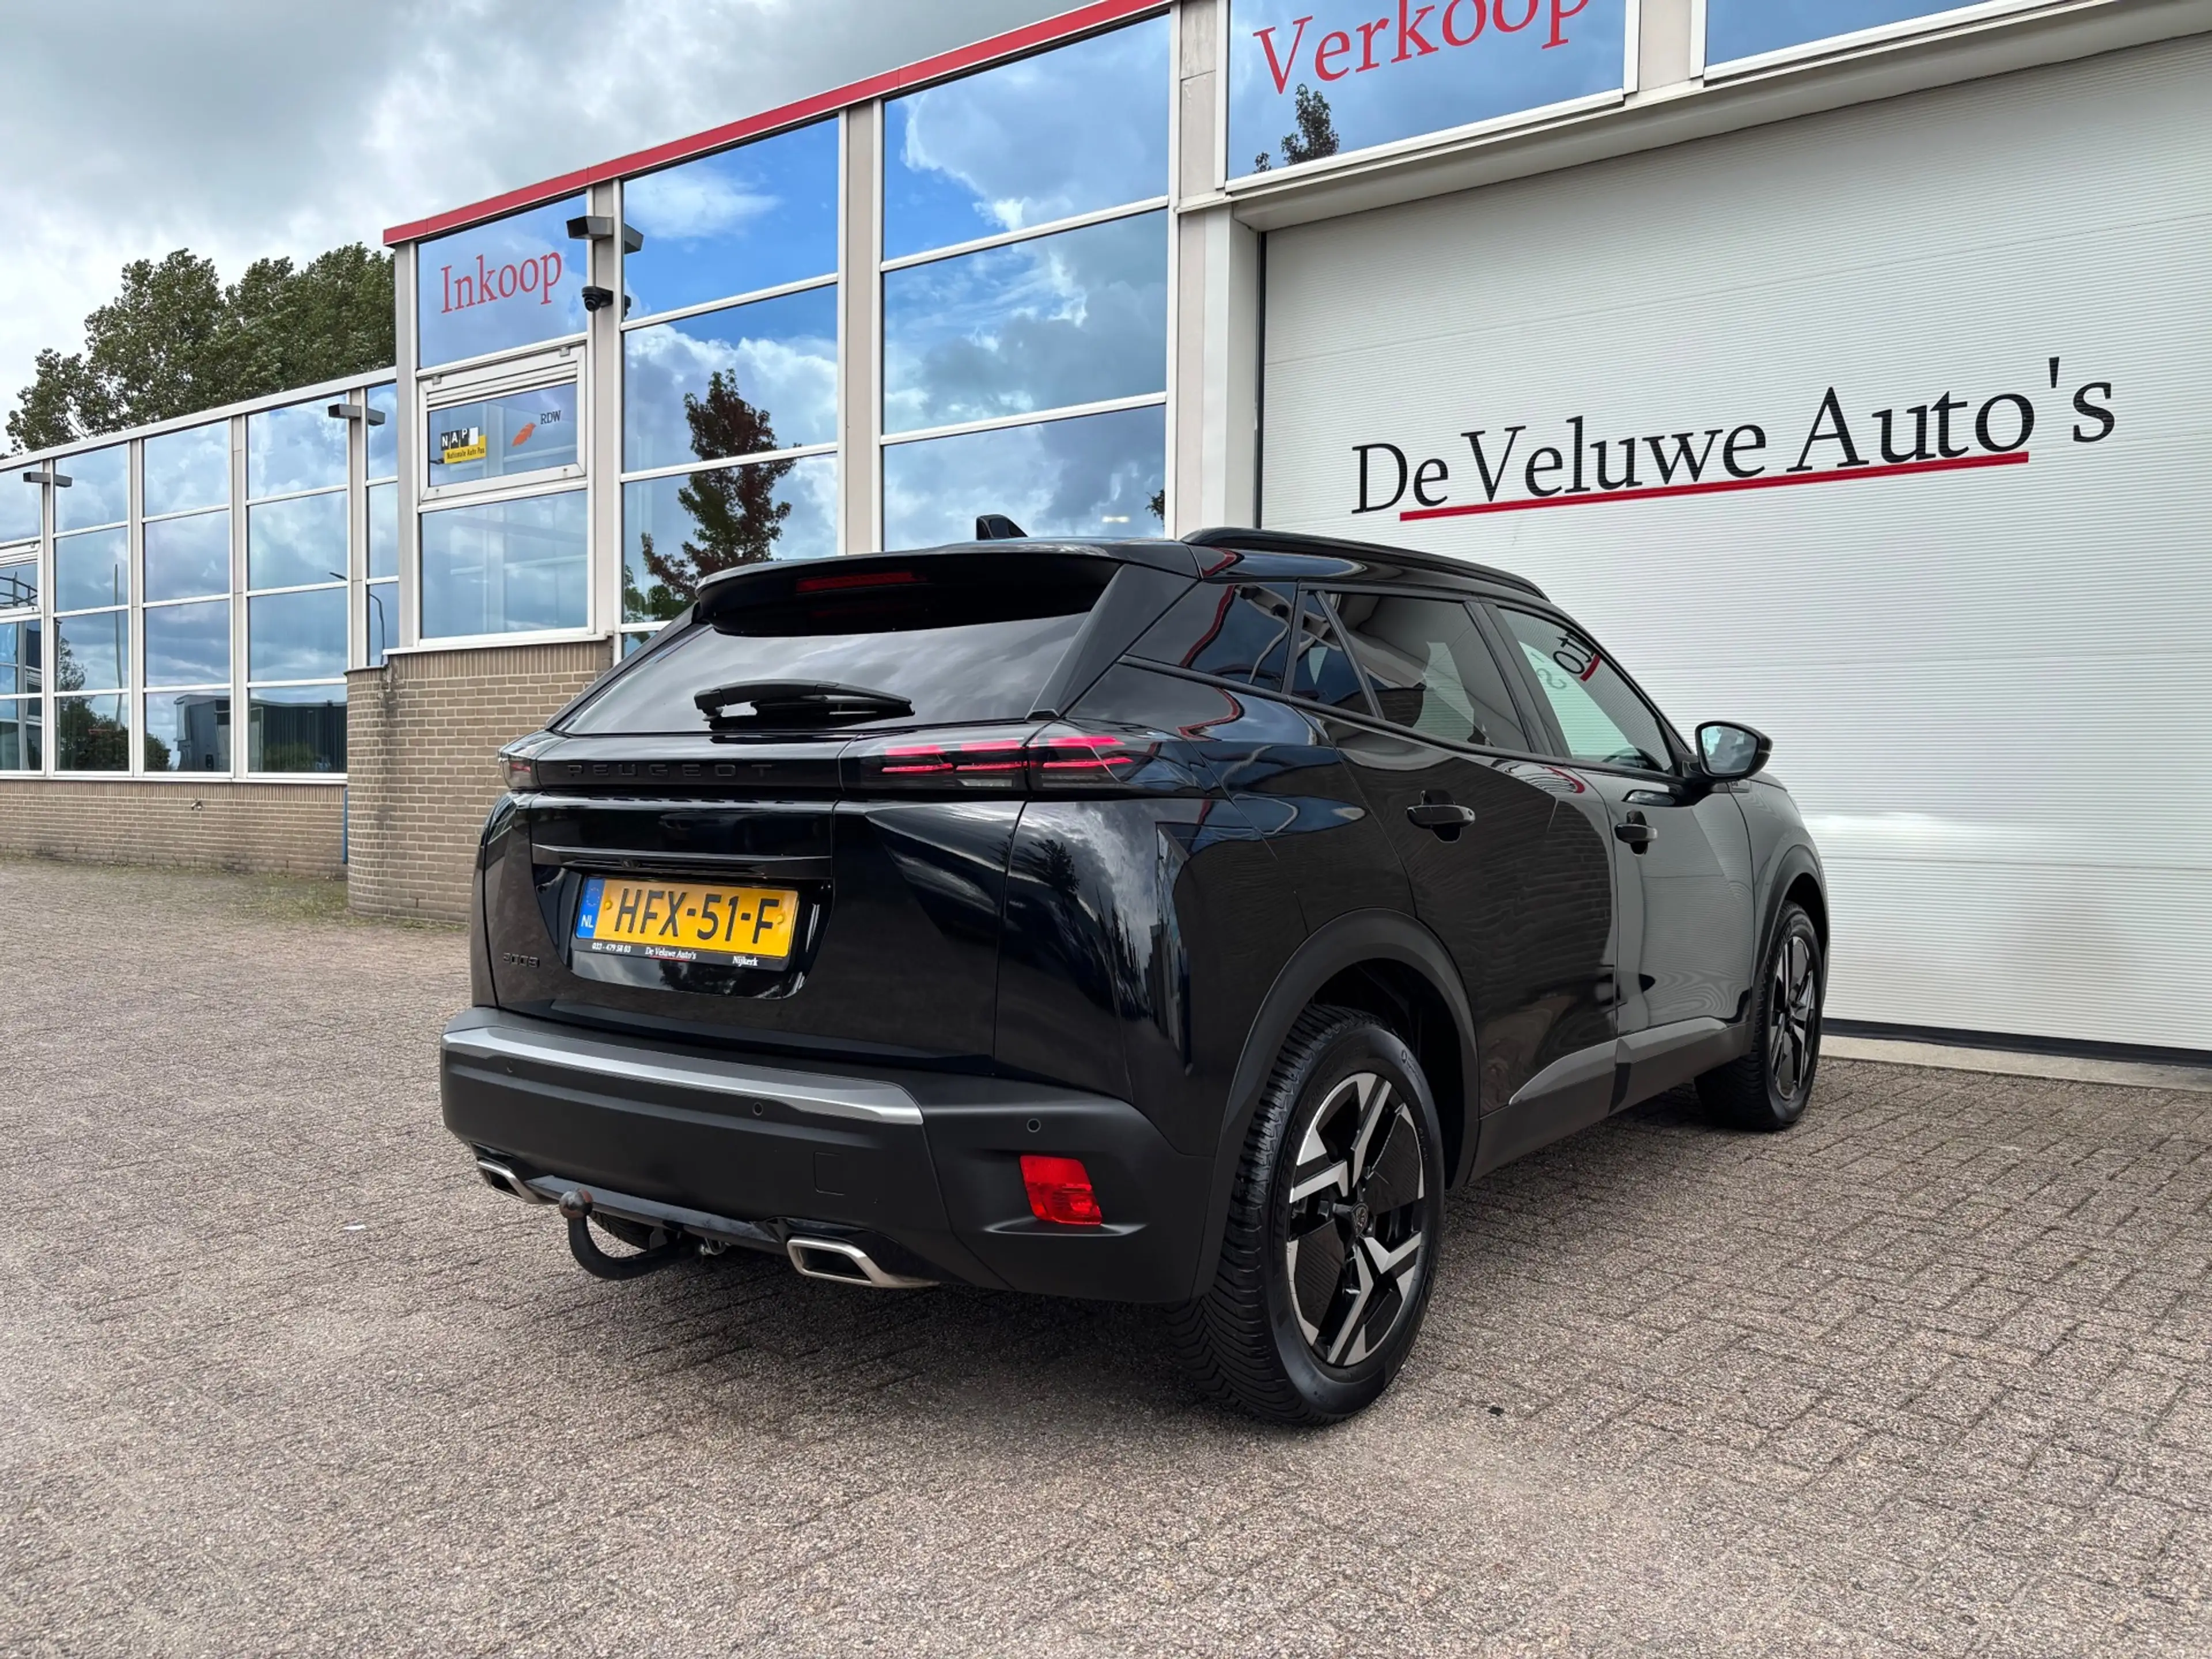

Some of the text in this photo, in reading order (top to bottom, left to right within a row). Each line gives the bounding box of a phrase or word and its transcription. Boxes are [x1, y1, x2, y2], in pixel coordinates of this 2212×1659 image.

[441, 252, 562, 313] Inkoop
[540, 410, 562, 425] RDW
[442, 428, 468, 448] NAP
[1351, 357, 2115, 514] De Veluwe Auto's
[567, 763, 774, 778] PEUGEOT
[581, 914, 594, 929] NL
[614, 888, 780, 945] HFX-51-F
[645, 946, 696, 960] De Veluwe Auto's
[732, 956, 759, 967] Nijkerk
